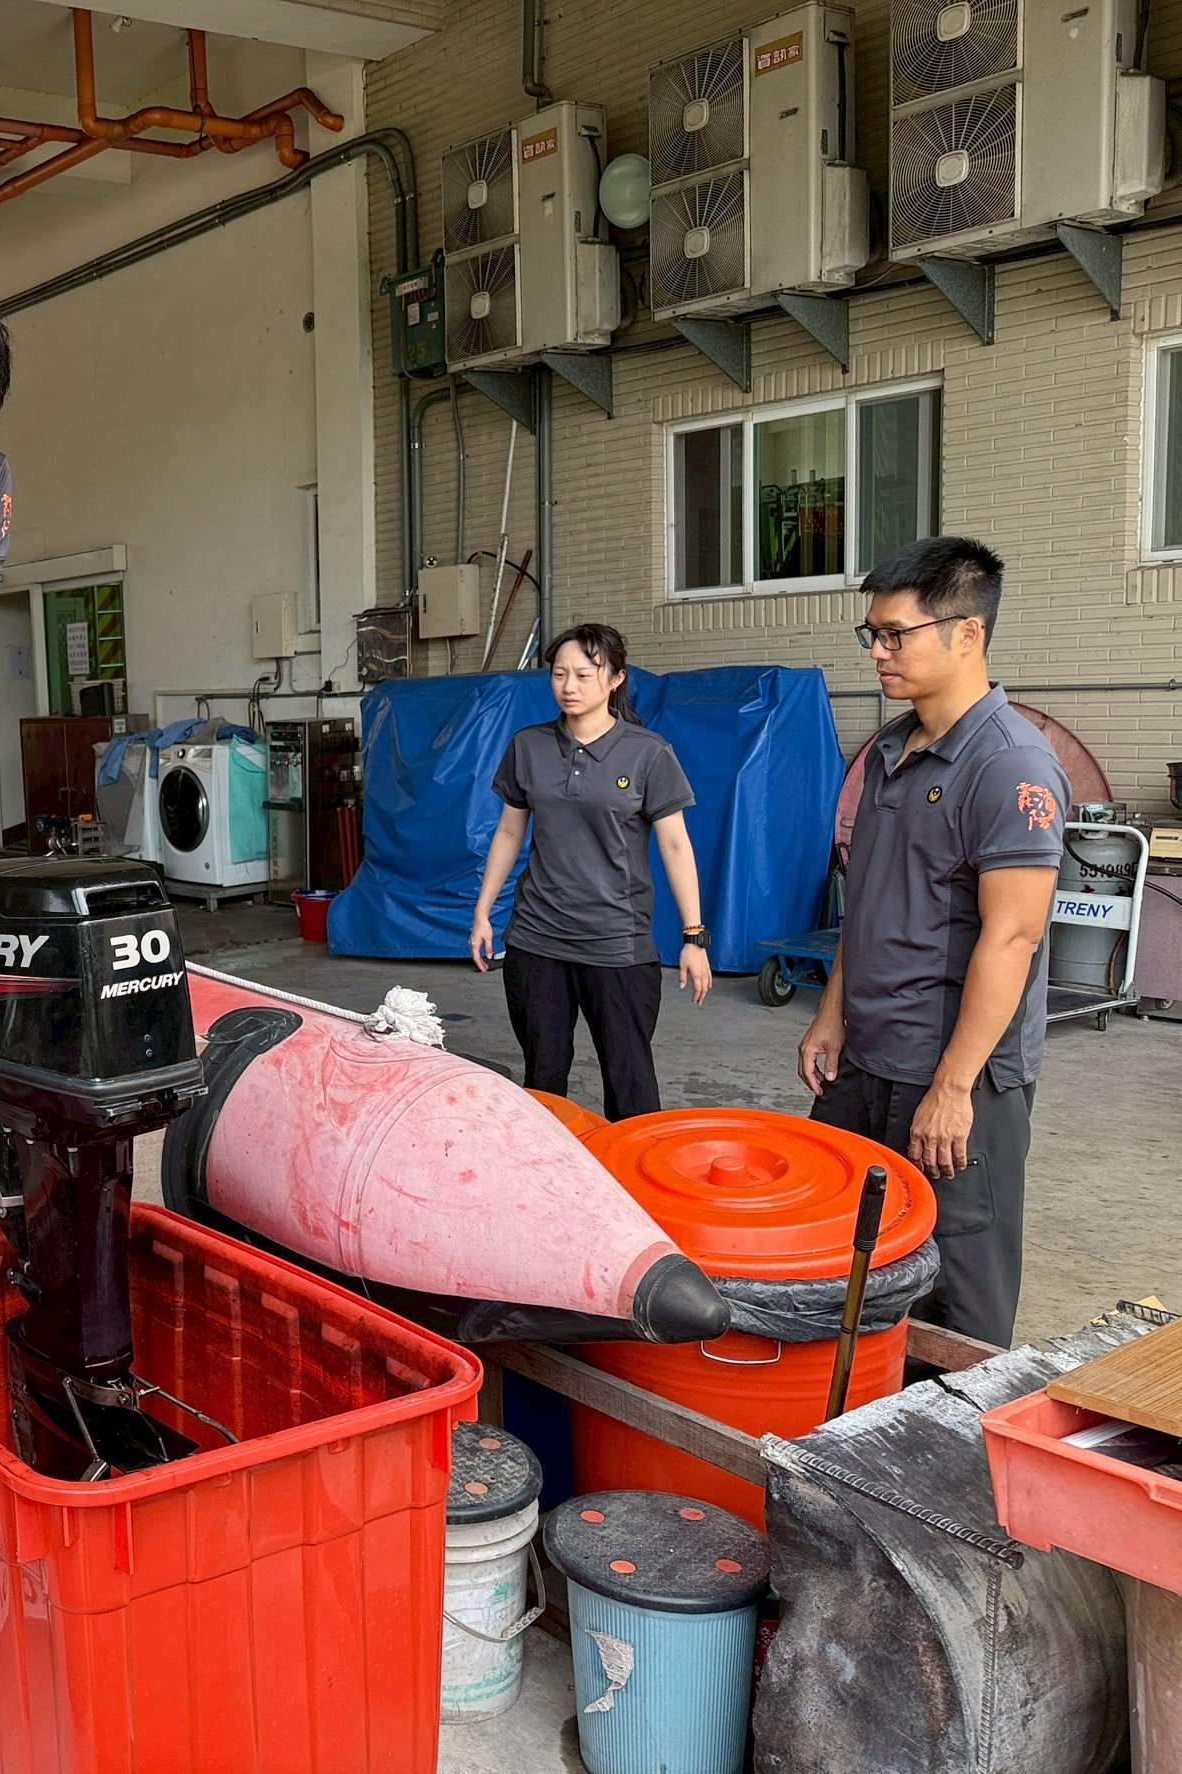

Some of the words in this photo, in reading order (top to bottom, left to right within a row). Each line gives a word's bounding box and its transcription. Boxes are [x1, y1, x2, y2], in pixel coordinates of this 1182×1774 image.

[1056, 900, 1114, 919] TRENY
[109, 929, 171, 970] 30
[100, 970, 184, 1000] MERCURY
